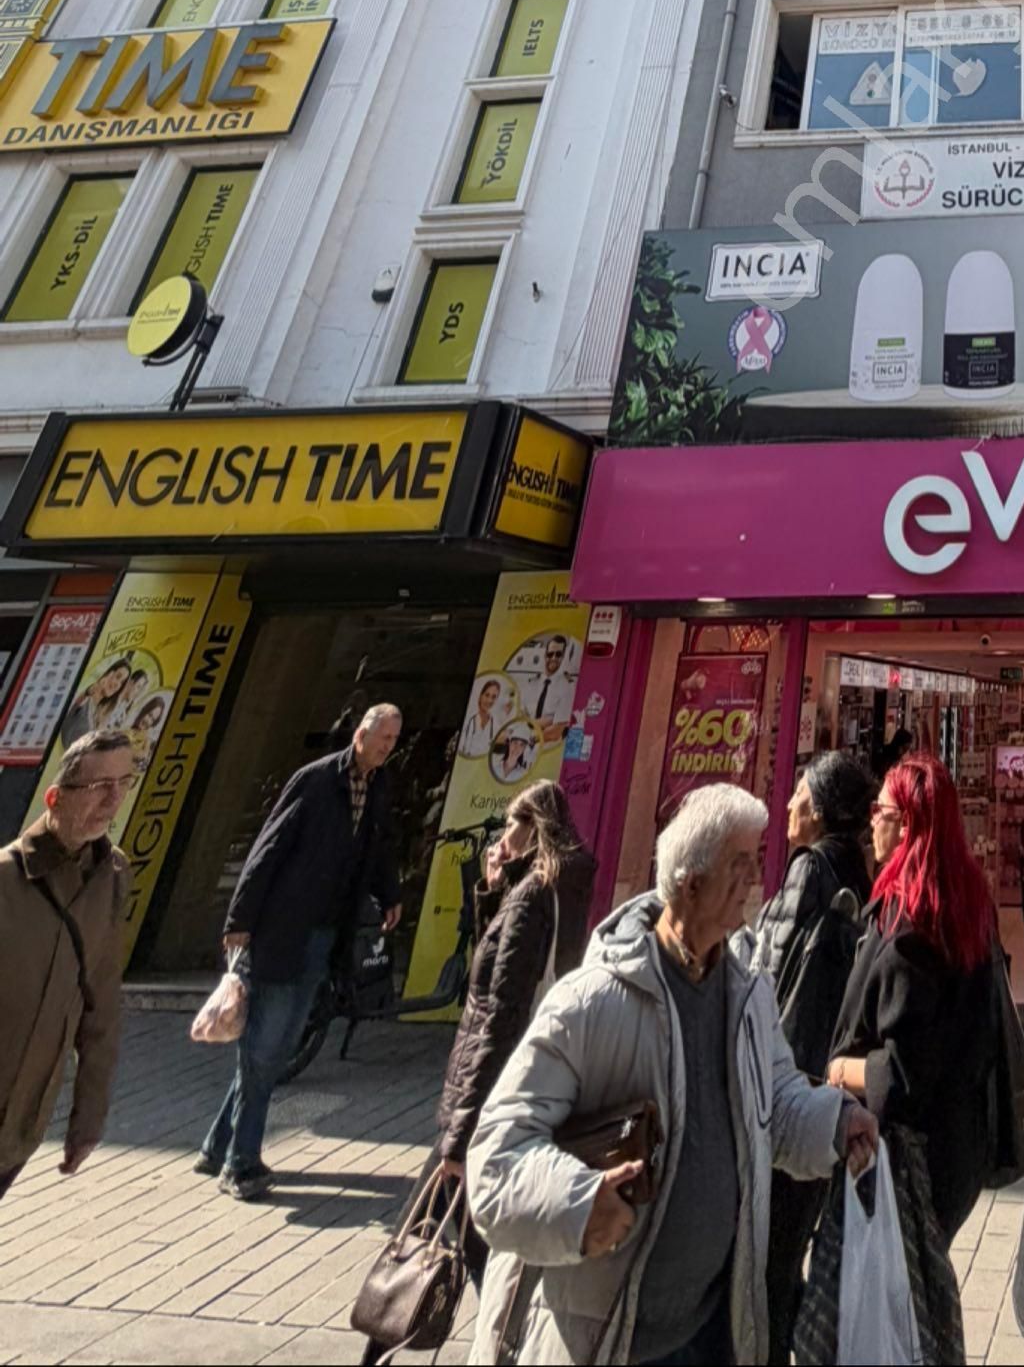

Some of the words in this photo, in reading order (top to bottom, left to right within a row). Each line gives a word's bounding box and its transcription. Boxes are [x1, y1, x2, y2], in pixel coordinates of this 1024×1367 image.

[522, 18, 545, 58] IELTS
[31, 23, 290, 119] TIME
[3, 106, 255, 145] DANIŞMANLIĞI
[481, 118, 518, 192] YÖKDİL
[947, 142, 1012, 155] İSTANBUL
[183, 227, 217, 277] GLISH
[205, 183, 235, 223] TIME
[50, 215, 98, 291] YKS-DİL
[722, 252, 807, 278] INCIA
[438, 301, 465, 345] YDS
[876, 364, 904, 375] INCIA
[44, 444, 298, 509] ENGLISH
[305, 440, 453, 502] TIME
[556, 477, 582, 502] TIM
[126, 596, 166, 608] ENGLISH
[171, 596, 196, 607] TIME
[508, 593, 551, 604] ENGLISH
[181, 623, 235, 723] TIME
[671, 707, 752, 749] %60
[470, 794, 513, 812] Kariye
